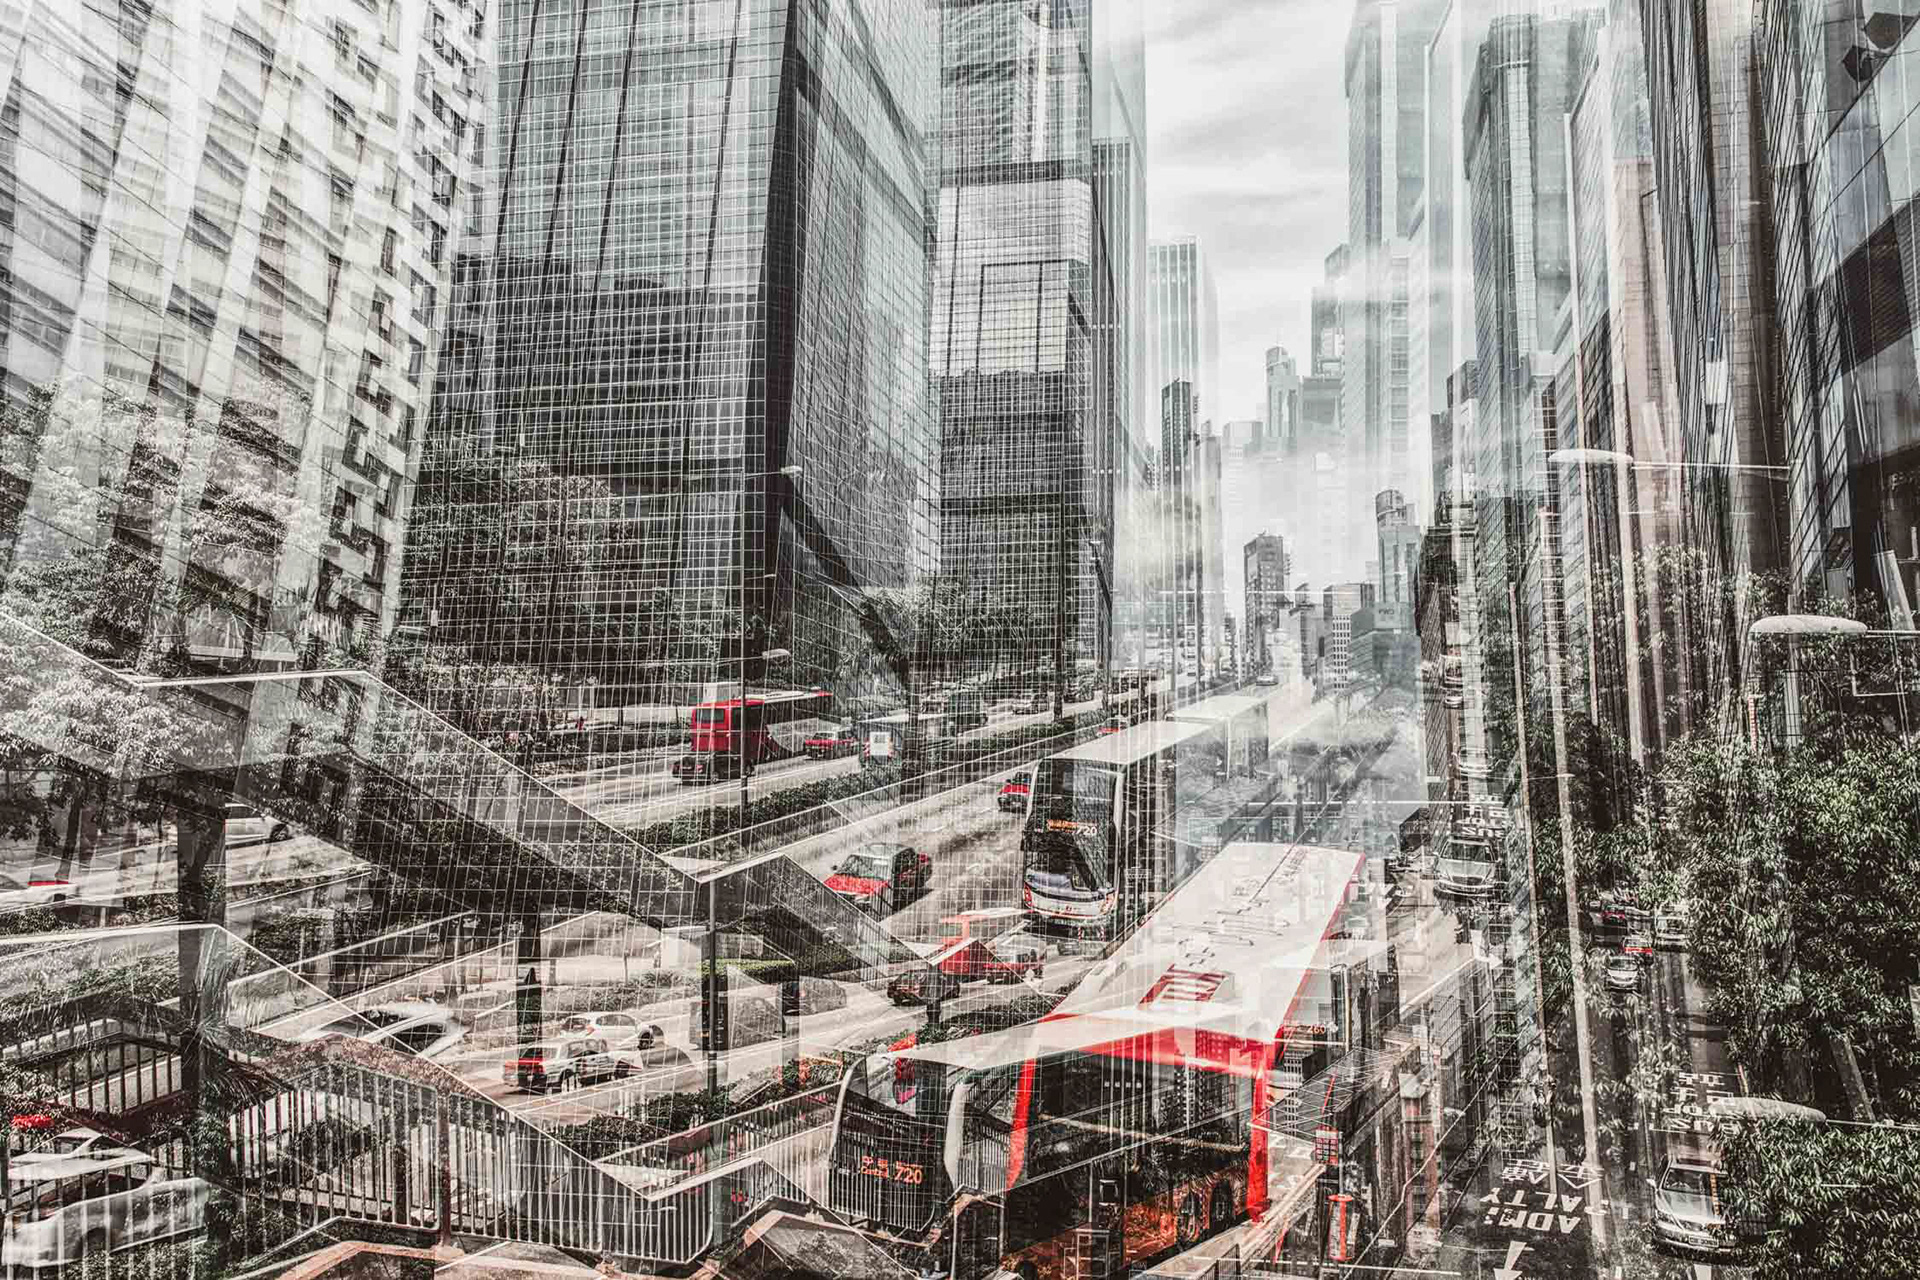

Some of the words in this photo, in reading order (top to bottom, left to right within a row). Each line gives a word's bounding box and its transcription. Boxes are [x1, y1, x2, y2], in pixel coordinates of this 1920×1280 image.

[1076, 825, 1097, 836] 720
[895, 1166, 923, 1184] 720
[1480, 1187, 1582, 1213] ALTY
